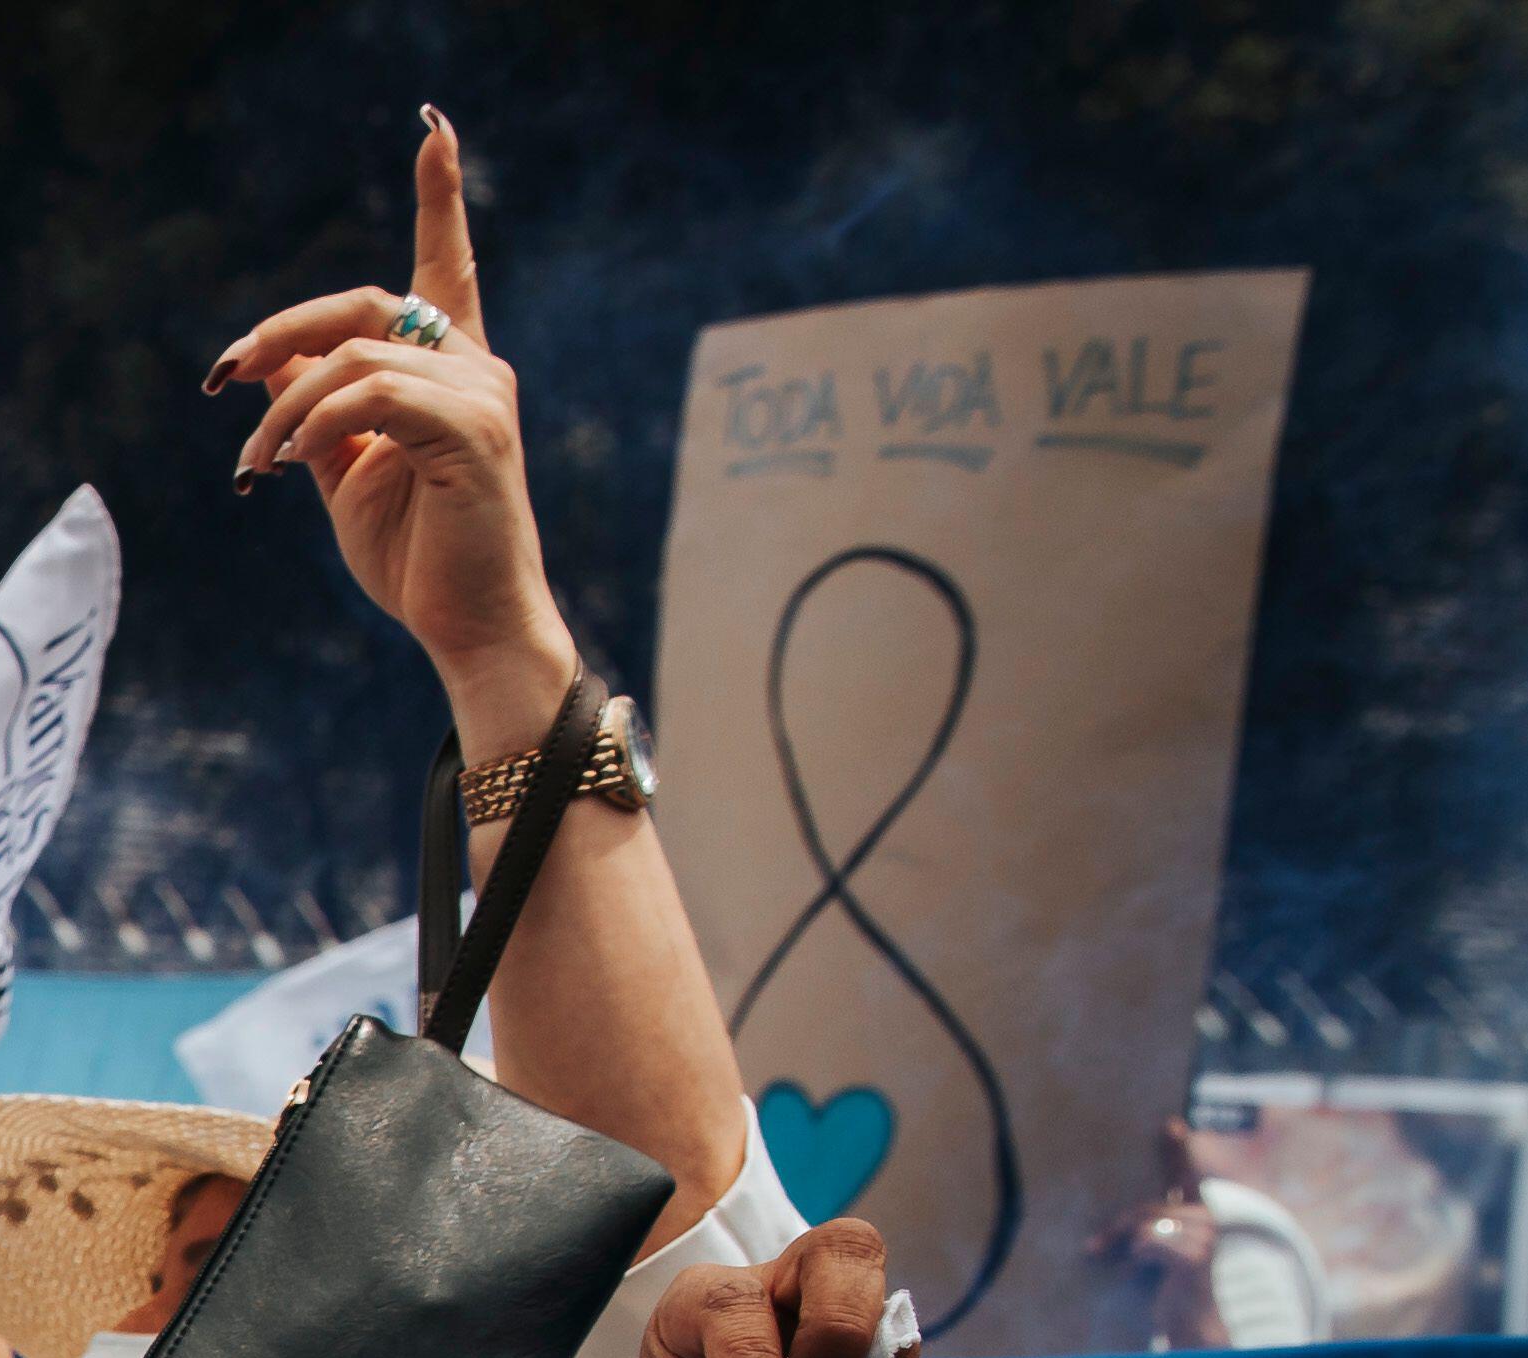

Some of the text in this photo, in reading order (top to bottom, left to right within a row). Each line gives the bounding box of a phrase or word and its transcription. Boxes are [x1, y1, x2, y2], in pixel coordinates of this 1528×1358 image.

[717, 334, 1224, 450] TODA VIDA VALE
